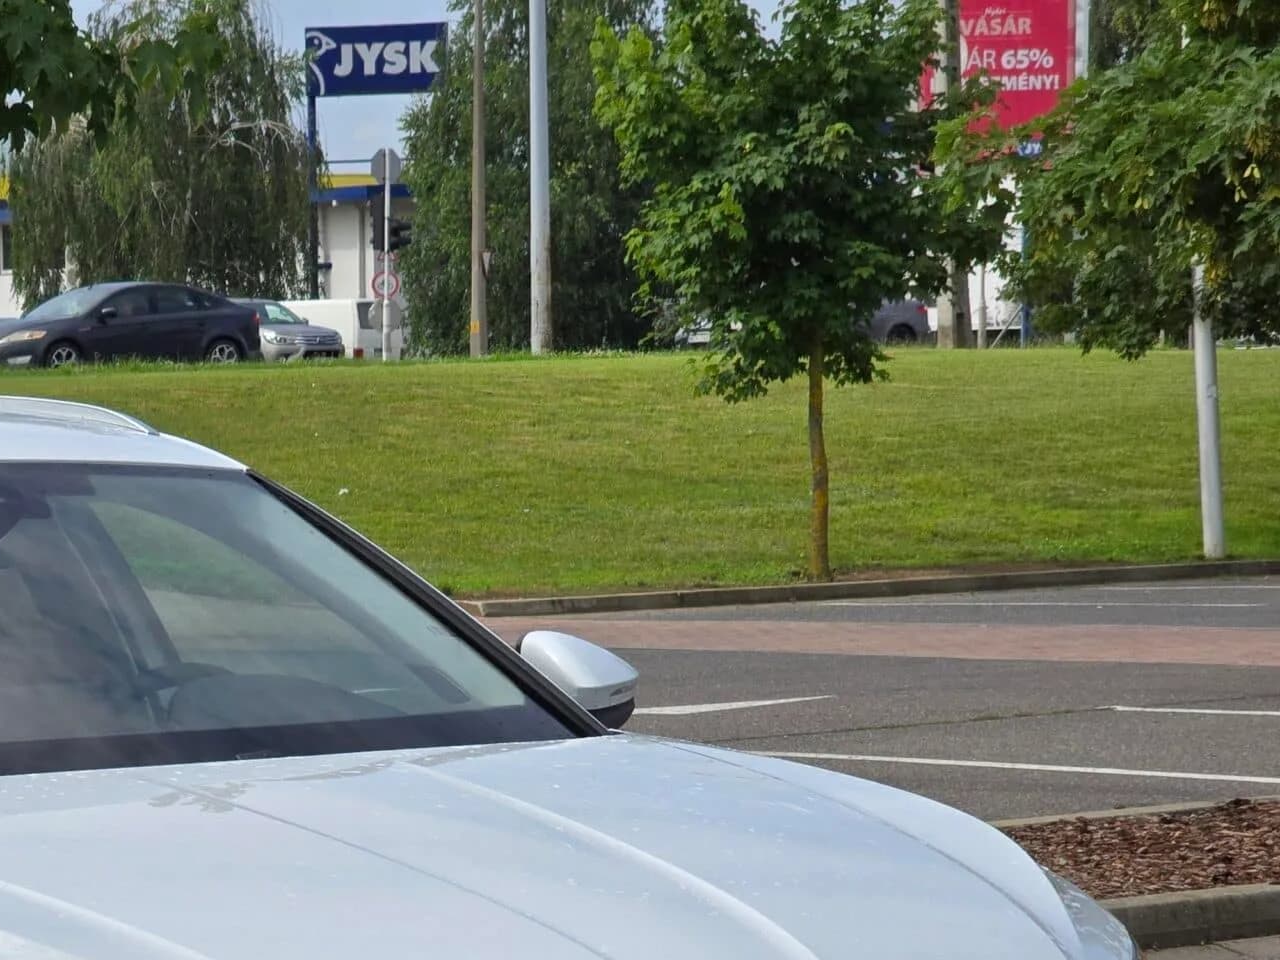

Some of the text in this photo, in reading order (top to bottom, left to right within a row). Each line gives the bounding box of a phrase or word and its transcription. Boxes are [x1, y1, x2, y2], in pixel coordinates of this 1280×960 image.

[960, 14, 1032, 36] VÁSÁR
[333, 40, 440, 77] JYSK
[1001, 48, 1054, 69] 65%
